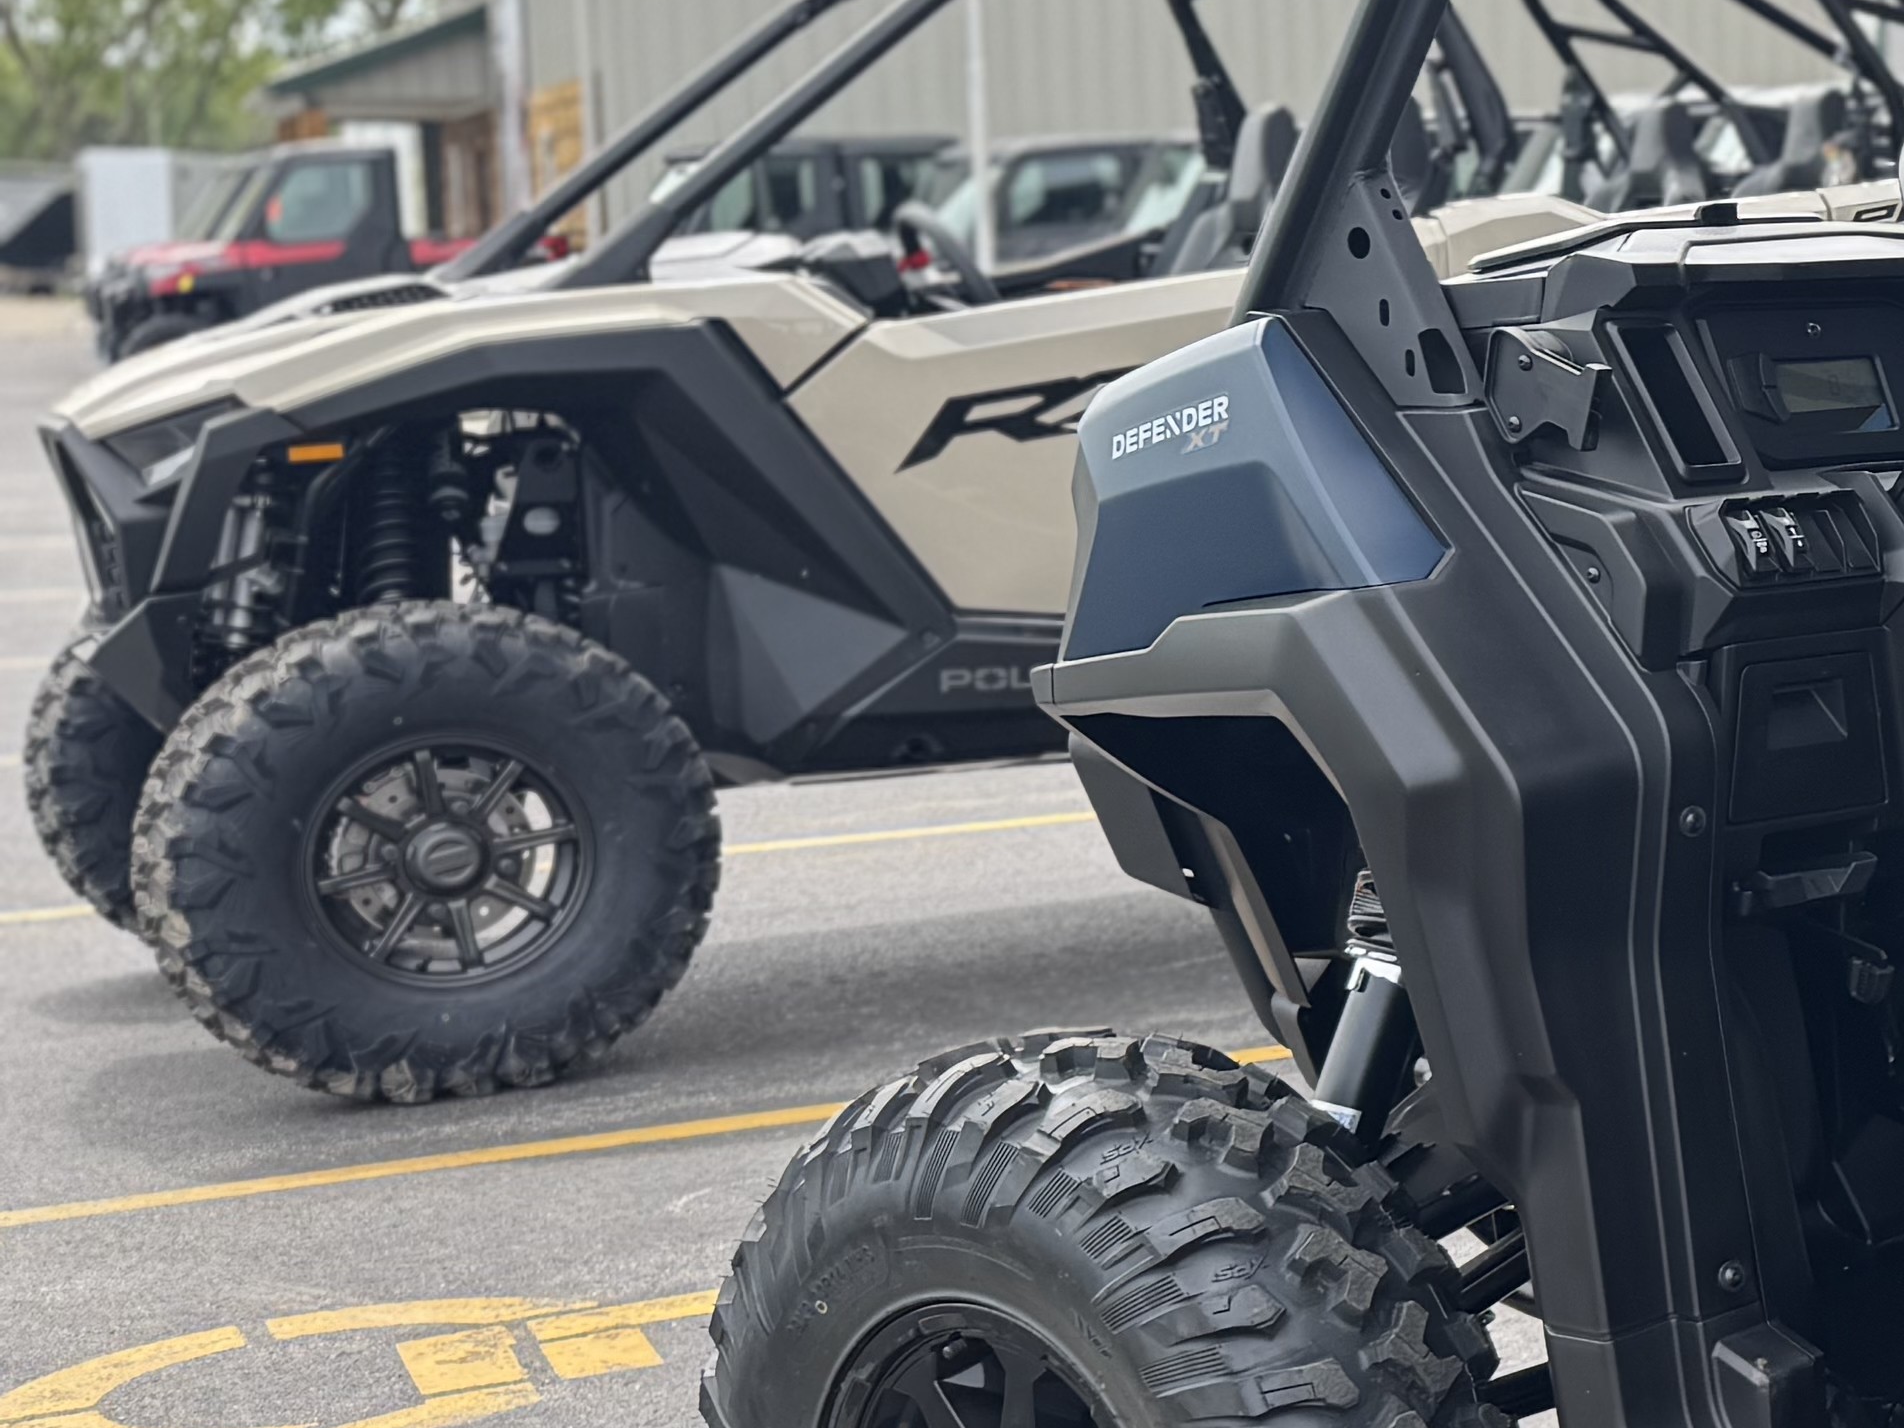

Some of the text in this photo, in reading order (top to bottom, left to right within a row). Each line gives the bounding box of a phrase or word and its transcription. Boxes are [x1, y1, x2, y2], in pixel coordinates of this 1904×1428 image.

[1111, 395, 1230, 460] DEFENDER
[1181, 419, 1230, 454] XT
[940, 667, 1032, 693] POL
